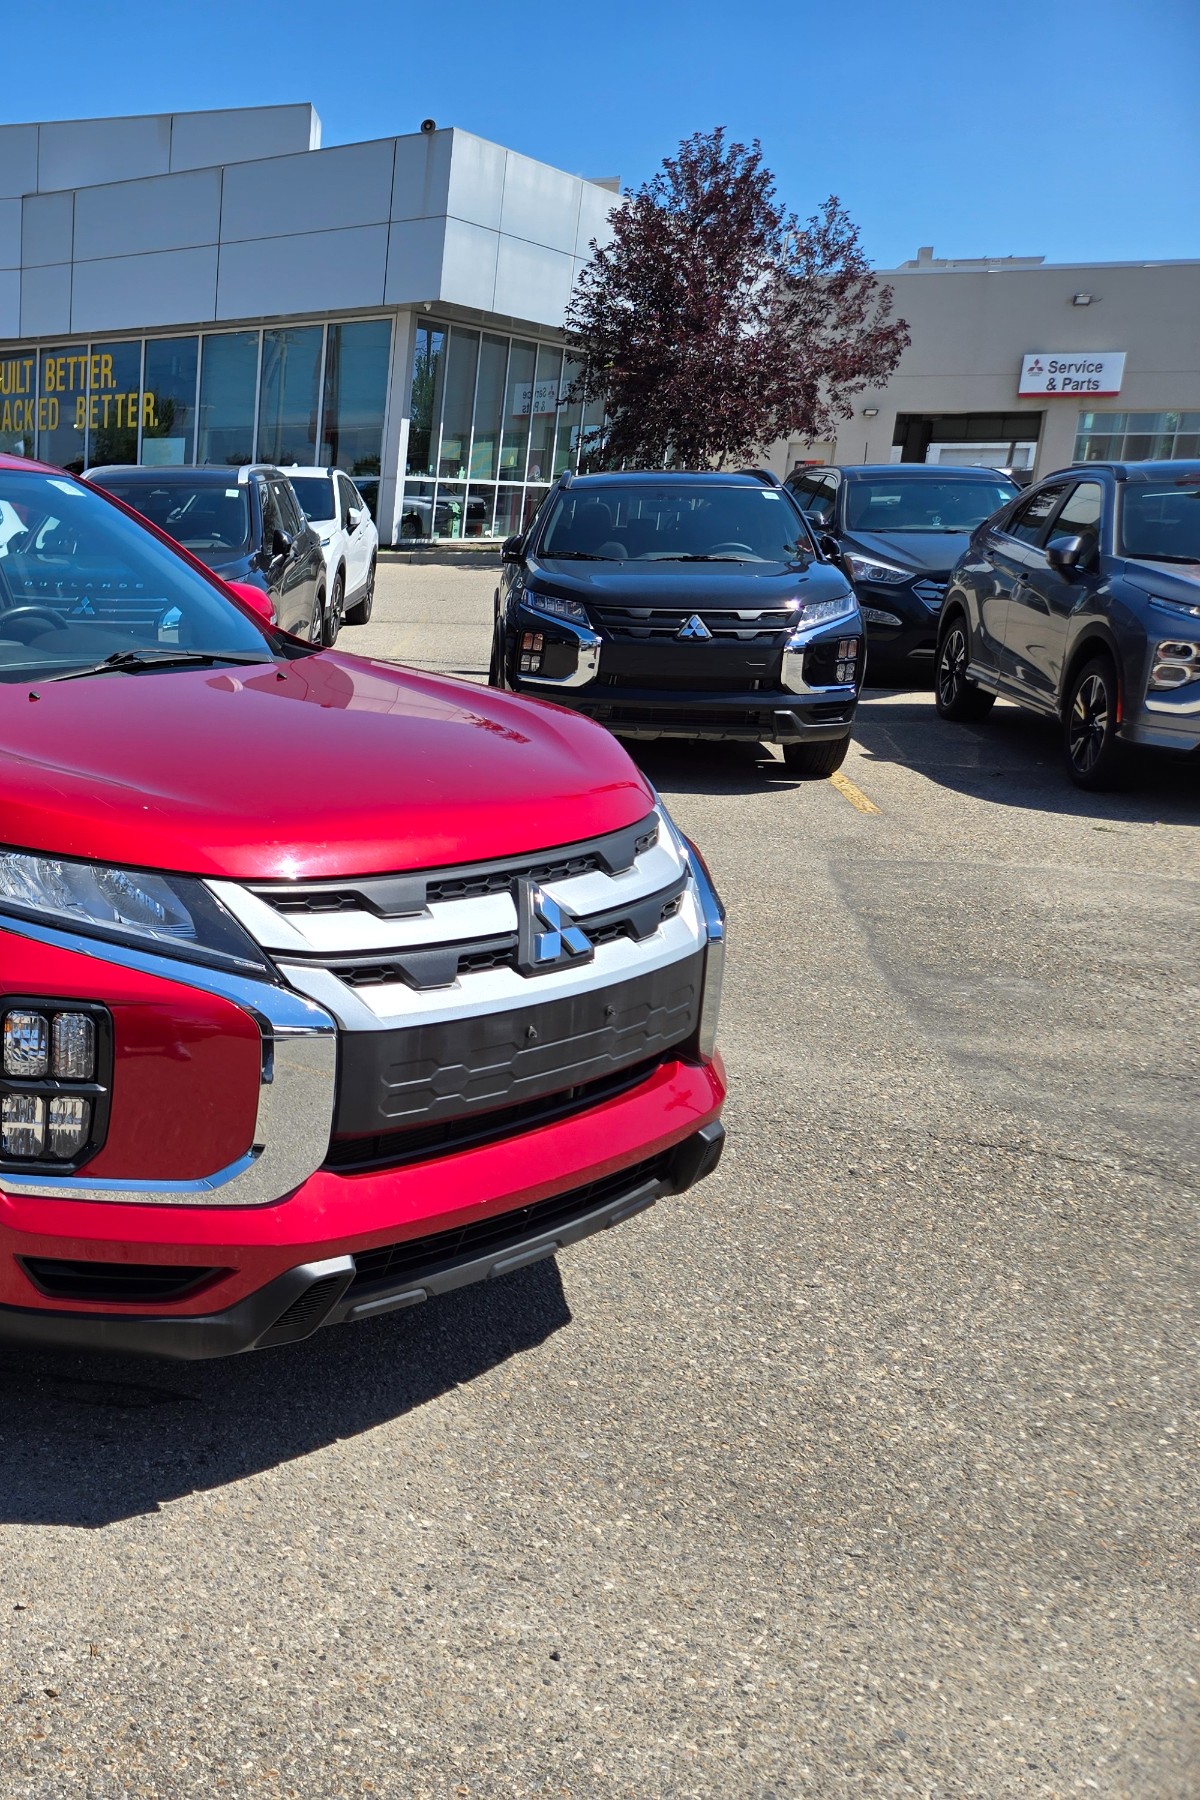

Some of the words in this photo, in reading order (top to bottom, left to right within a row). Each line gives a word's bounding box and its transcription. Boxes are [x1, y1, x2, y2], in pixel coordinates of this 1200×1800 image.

[45, 354, 117, 392] BETTER.
[1047, 360, 1104, 374] Service
[1046, 377, 1057, 391] &
[1061, 377, 1100, 391] Parts
[75, 392, 159, 430] BETTER.
